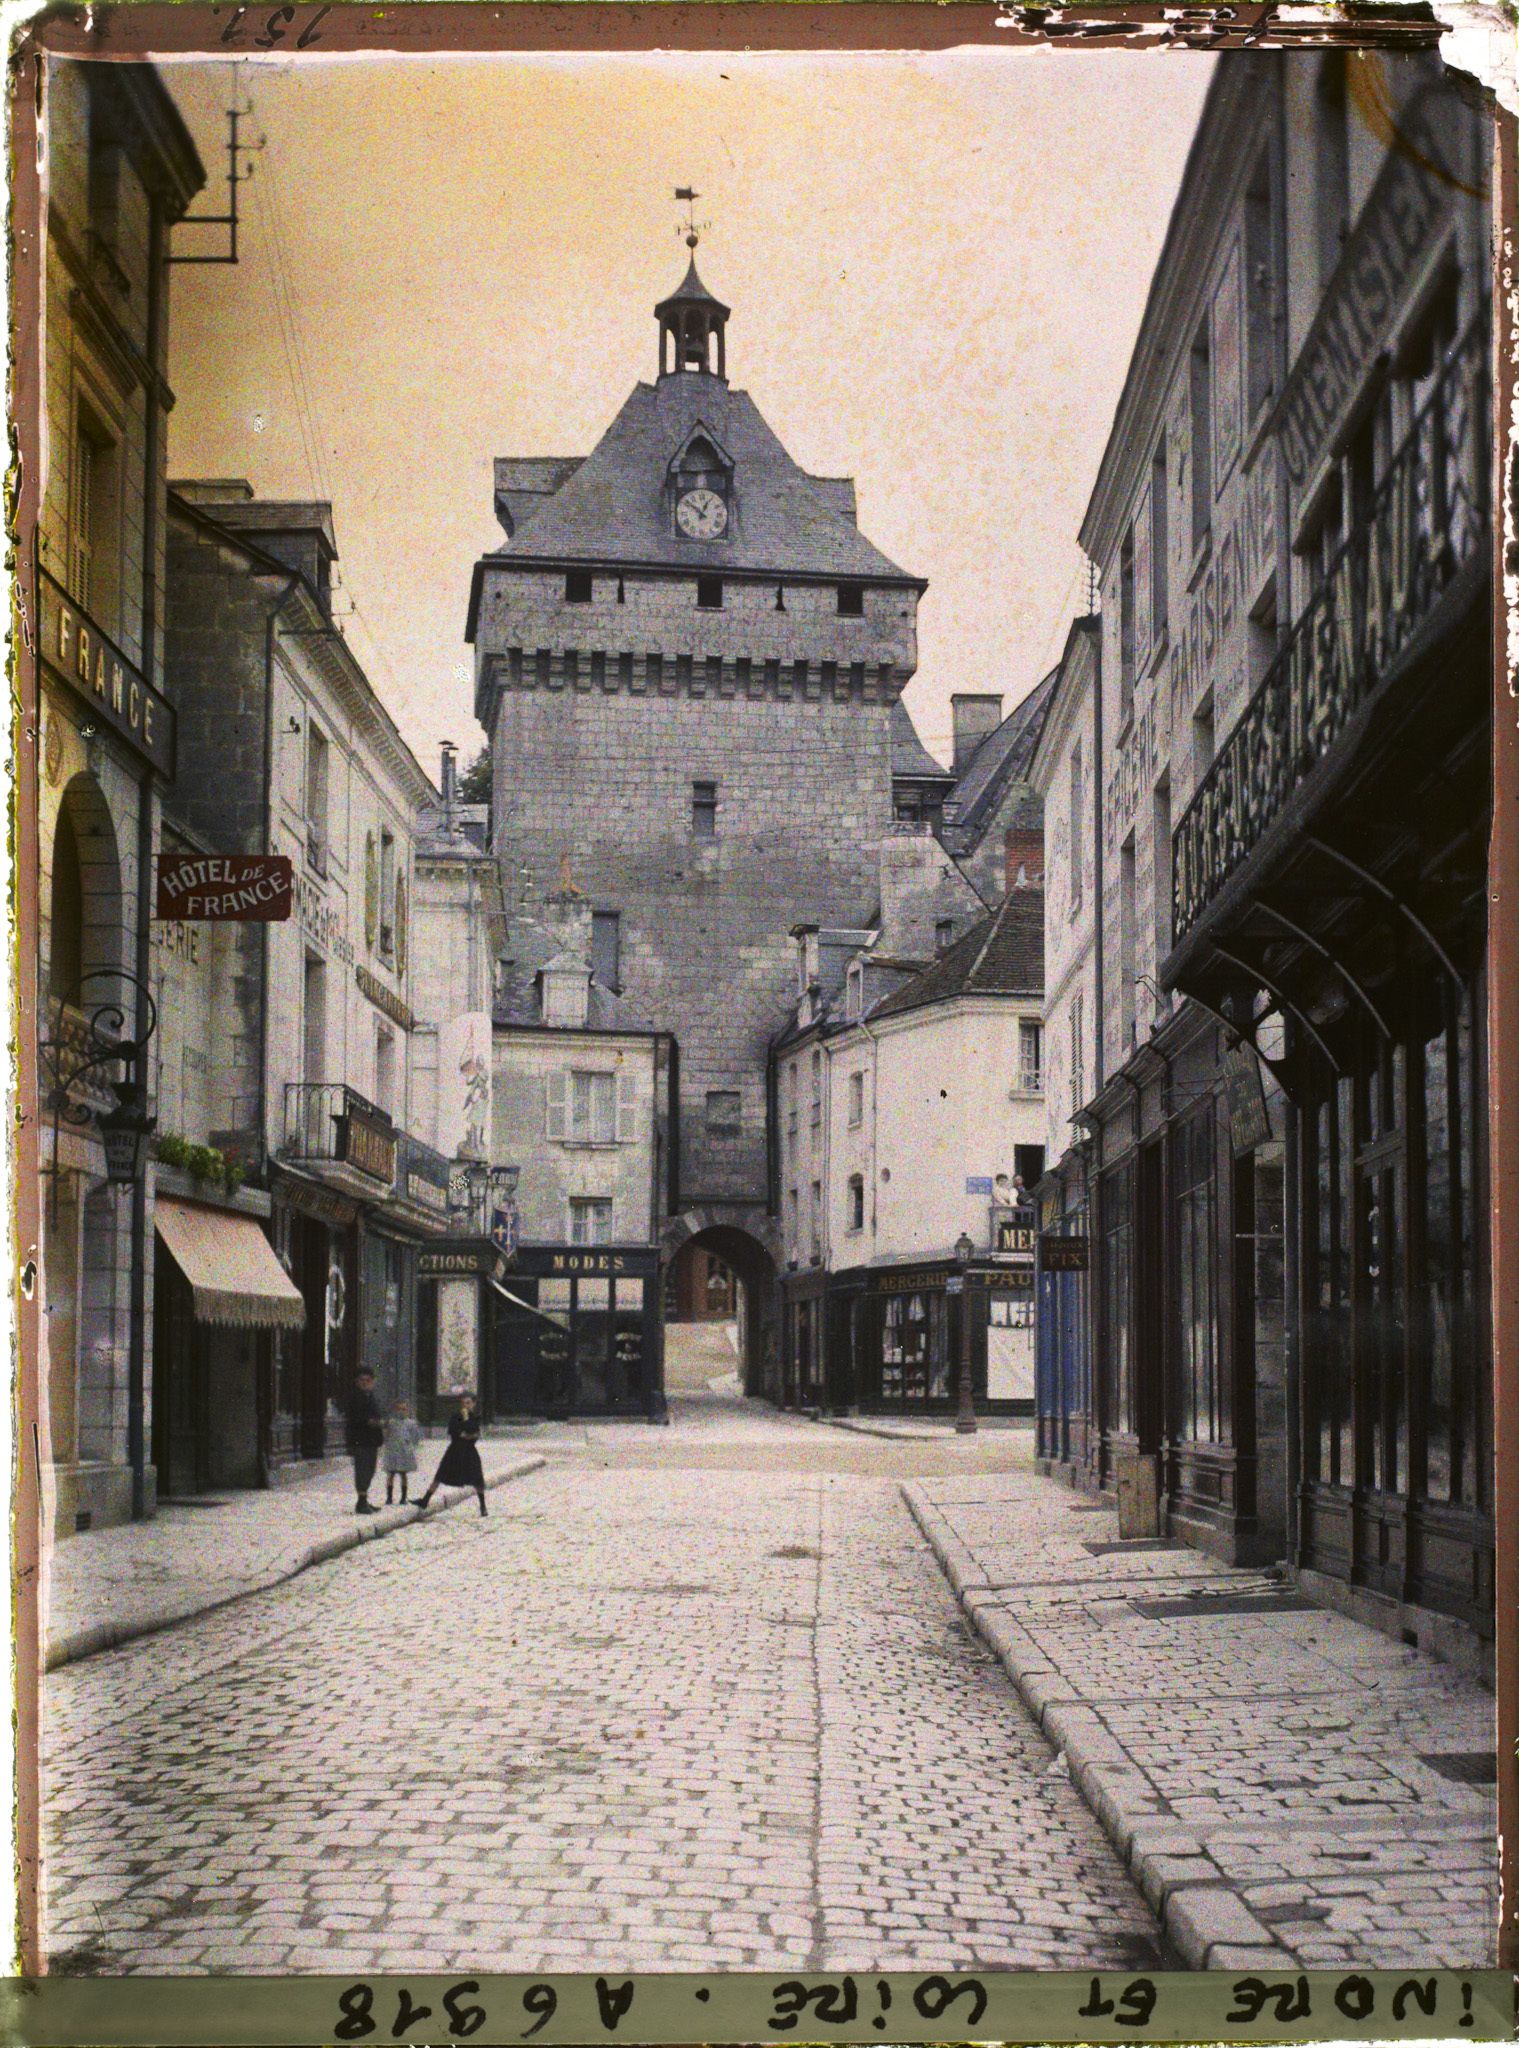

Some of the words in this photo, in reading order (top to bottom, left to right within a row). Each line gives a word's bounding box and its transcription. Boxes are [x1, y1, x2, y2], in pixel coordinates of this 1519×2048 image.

[59, 606, 155, 745] FRANCE
[160, 860, 236, 899] HÔTEL
[239, 864, 265, 881] DE
[186, 871, 289, 916] FRANCE
[553, 1255, 624, 1269] MODES
[1078, 1977, 1157, 2027] ET
